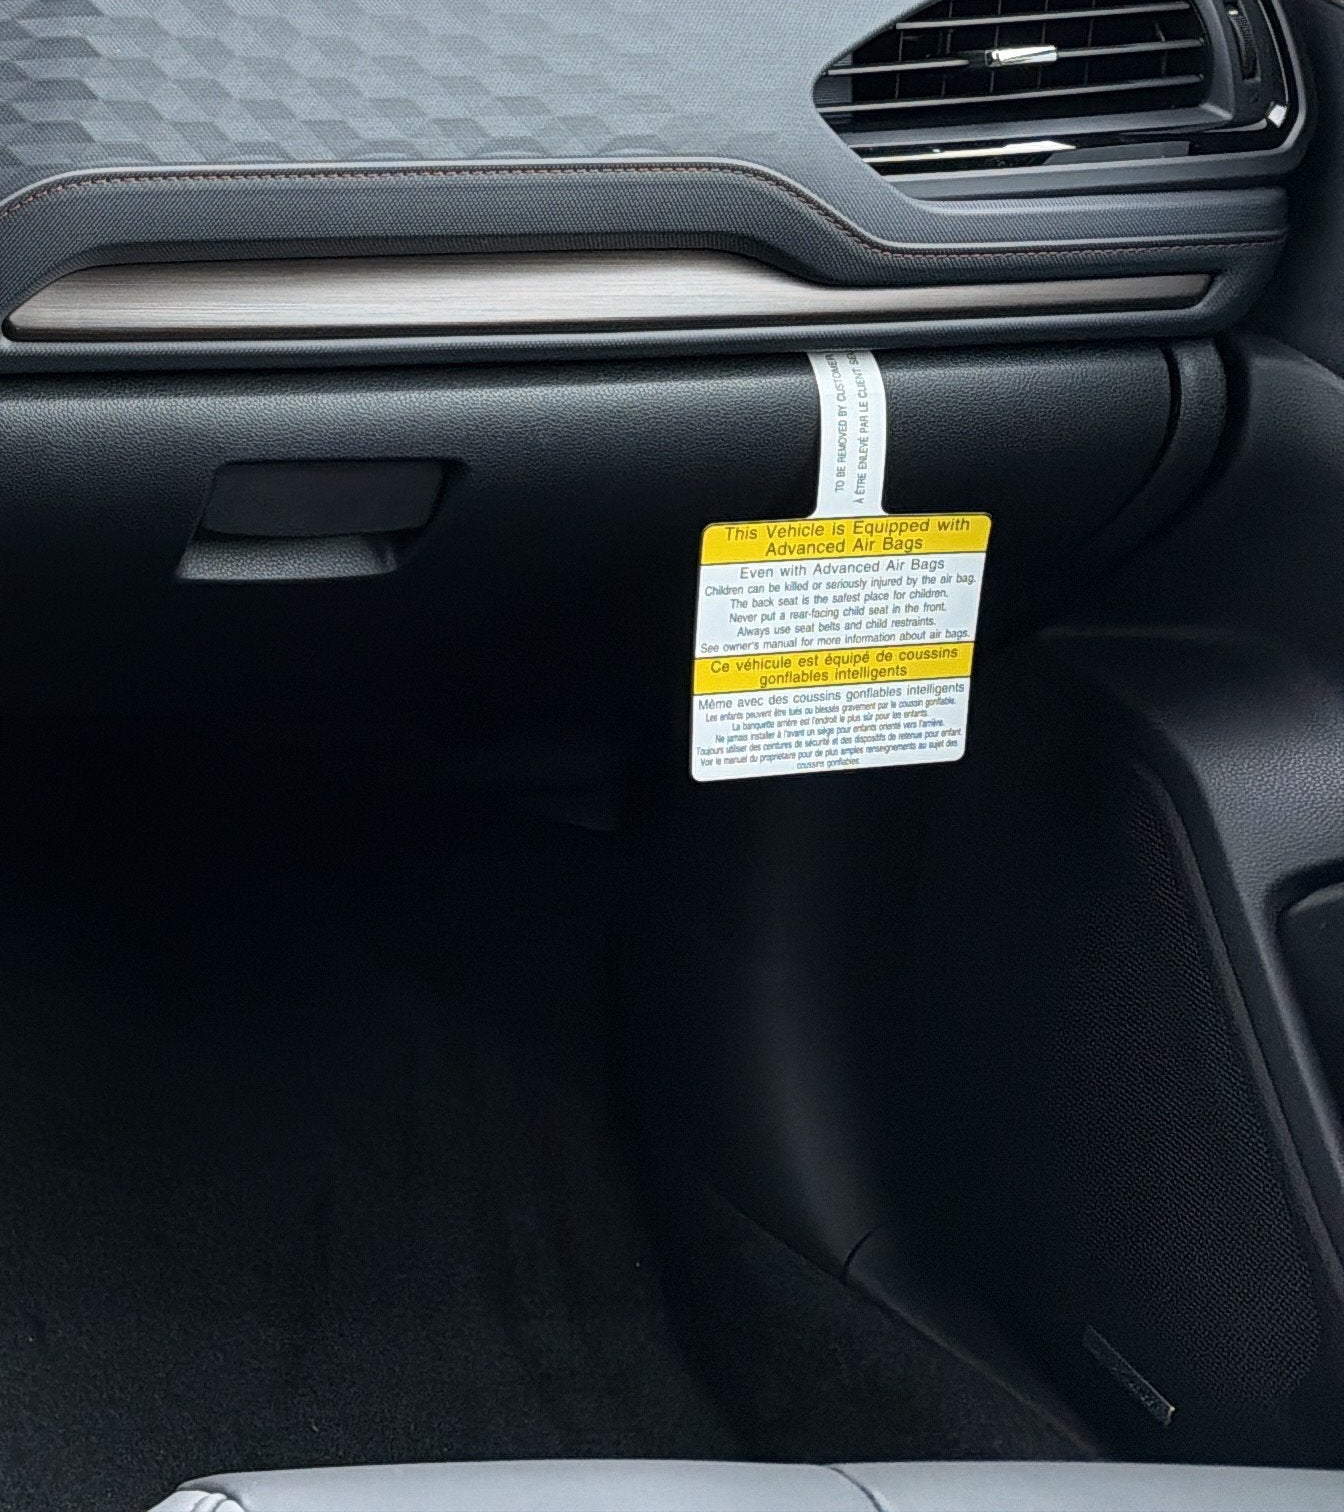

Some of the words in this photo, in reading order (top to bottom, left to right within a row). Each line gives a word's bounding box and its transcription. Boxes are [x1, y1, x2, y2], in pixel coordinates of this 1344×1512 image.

[838, 405, 848, 417] BY
[858, 401, 869, 414] LE
[860, 416, 869, 434] PAR
[836, 419, 848, 464] REMOVED
[836, 466, 846, 478] BE
[835, 480, 846, 493] TO
[725, 526, 757, 540] This
[766, 523, 824, 538] Vehicle
[831, 522, 844, 535] is
[853, 518, 929, 534] Equipped
[937, 518, 969, 531] with
[765, 539, 845, 555] Advanced
[852, 537, 875, 551] Air
[882, 536, 922, 552] Bags
[739, 566, 773, 579] Even
[779, 564, 806, 576] with
[812, 560, 879, 575] Advanced
[885, 558, 905, 571] Air
[910, 558, 944, 572] Bags
[704, 584, 743, 596] Children
[747, 584, 764, 594] can
[768, 582, 780, 592] be
[784, 580, 809, 591] killed
[811, 581, 822, 590] or
[825, 577, 867, 590] seriously
[870, 575, 903, 589] injured
[905, 574, 918, 588] by
[921, 574, 936, 585] the
[939, 573, 953, 584] air
[729, 598, 748, 609] The
[751, 596, 774, 608] back
[777, 596, 798, 606] seat
[801, 594, 809, 605] is
[813, 594, 828, 604] the
[831, 592, 860, 603] safest
[863, 591, 889, 603] place
[892, 590, 906, 600] for
[729, 612, 757, 623] Never
[760, 610, 776, 623] put
[778, 611, 785, 620] a
[789, 607, 839, 619] rear-facing
[842, 605, 865, 616] child
[868, 604, 888, 615] seat
[891, 603, 900, 614] in
[904, 603, 919, 613] the
[736, 626, 770, 637] Always
[773, 625, 791, 634] use
[794, 622, 814, 633] seat
[817, 621, 840, 632] belts
[843, 619, 862, 630] and
[865, 618, 887, 629] child
[700, 642, 719, 653] See
[762, 637, 797, 648] manual
[800, 636, 814, 646] for
[816, 636, 841, 645] more
[844, 632, 895, 643] information
[898, 630, 926, 641] about
[928, 628, 943, 639] air
[710, 660, 729, 673] Ce
[736, 656, 791, 671] véhicule
[797, 654, 818, 667] est
[824, 651, 869, 666] équipé
[875, 649, 892, 662] de
[898, 647, 957, 660] coussins
[759, 669, 828, 687] gonflables
[835, 665, 907, 680] intelligents
[698, 698, 732, 710] Même
[737, 696, 763, 707] avec
[768, 694, 788, 705] des
[792, 690, 841, 703] coussins
[845, 686, 902, 701] gonflables
[906, 682, 964, 695] intelligents
